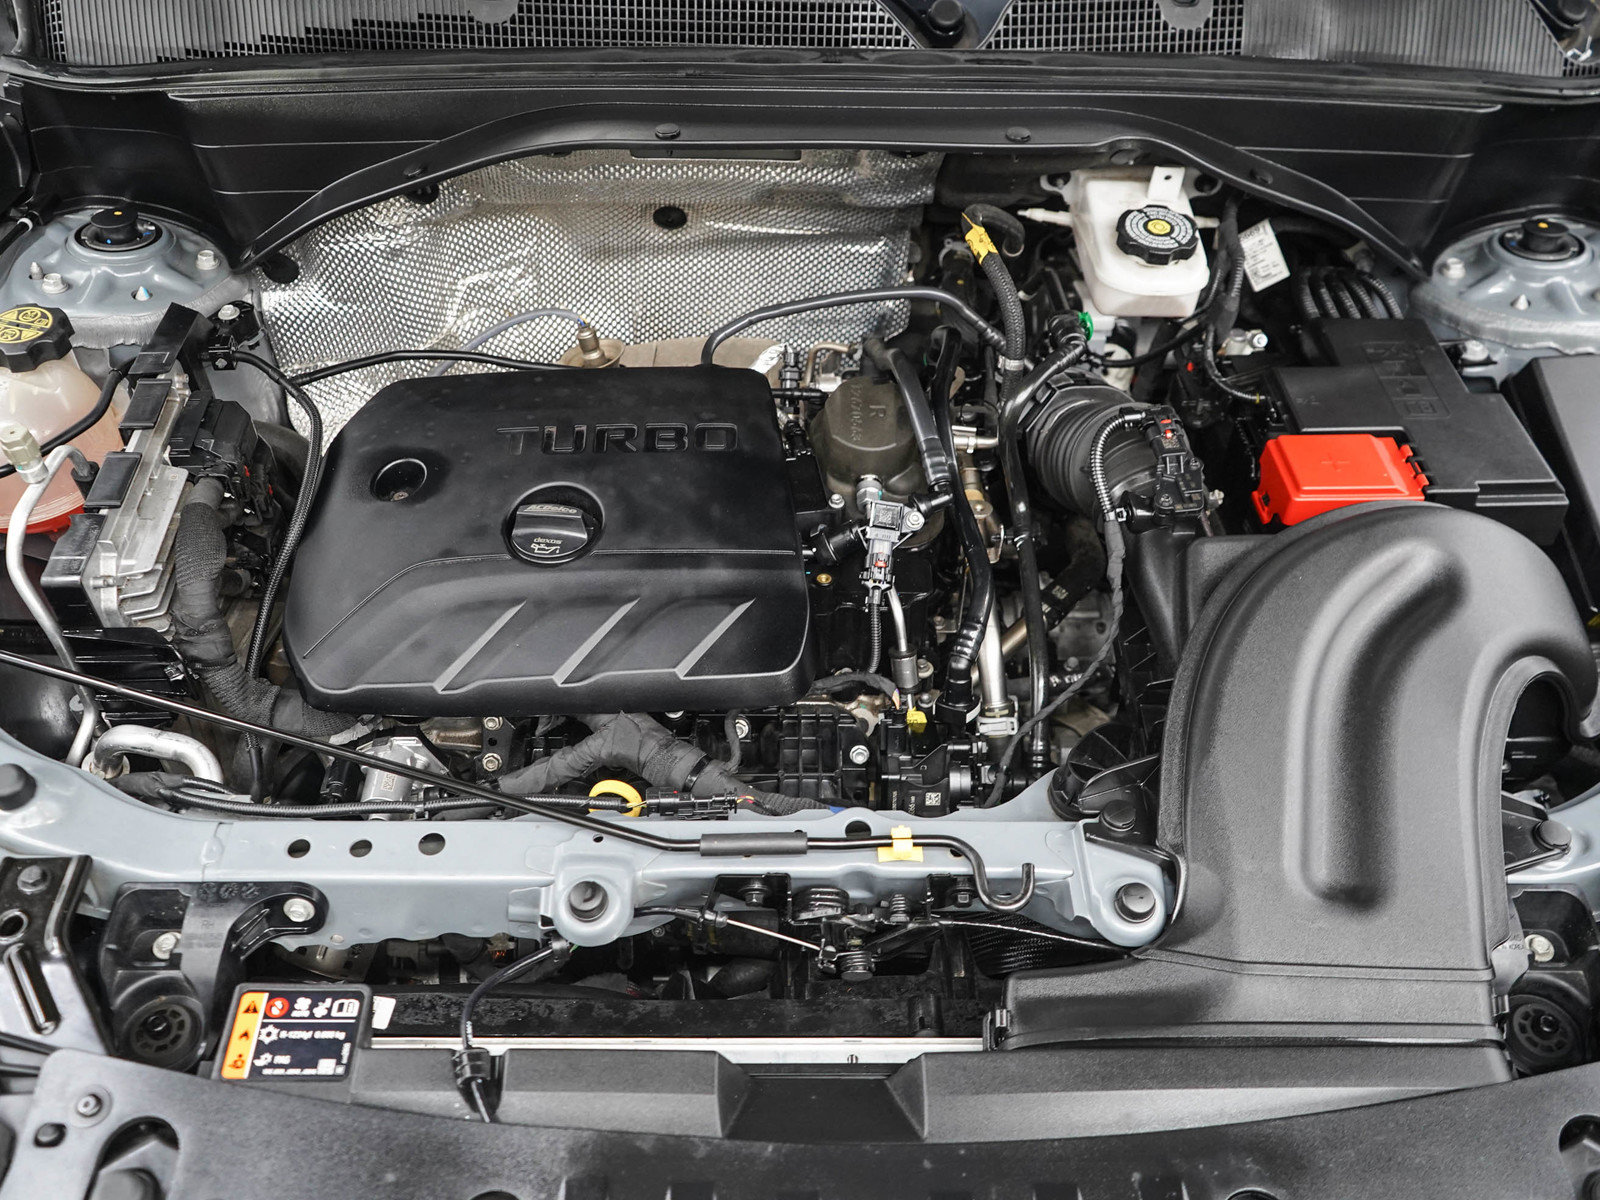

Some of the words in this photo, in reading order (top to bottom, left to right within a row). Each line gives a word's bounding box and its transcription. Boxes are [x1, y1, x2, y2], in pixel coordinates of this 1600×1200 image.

[497, 422, 738, 455] TURBO
[524, 504, 577, 514] ACDelco
[533, 537, 563, 545] dexos
